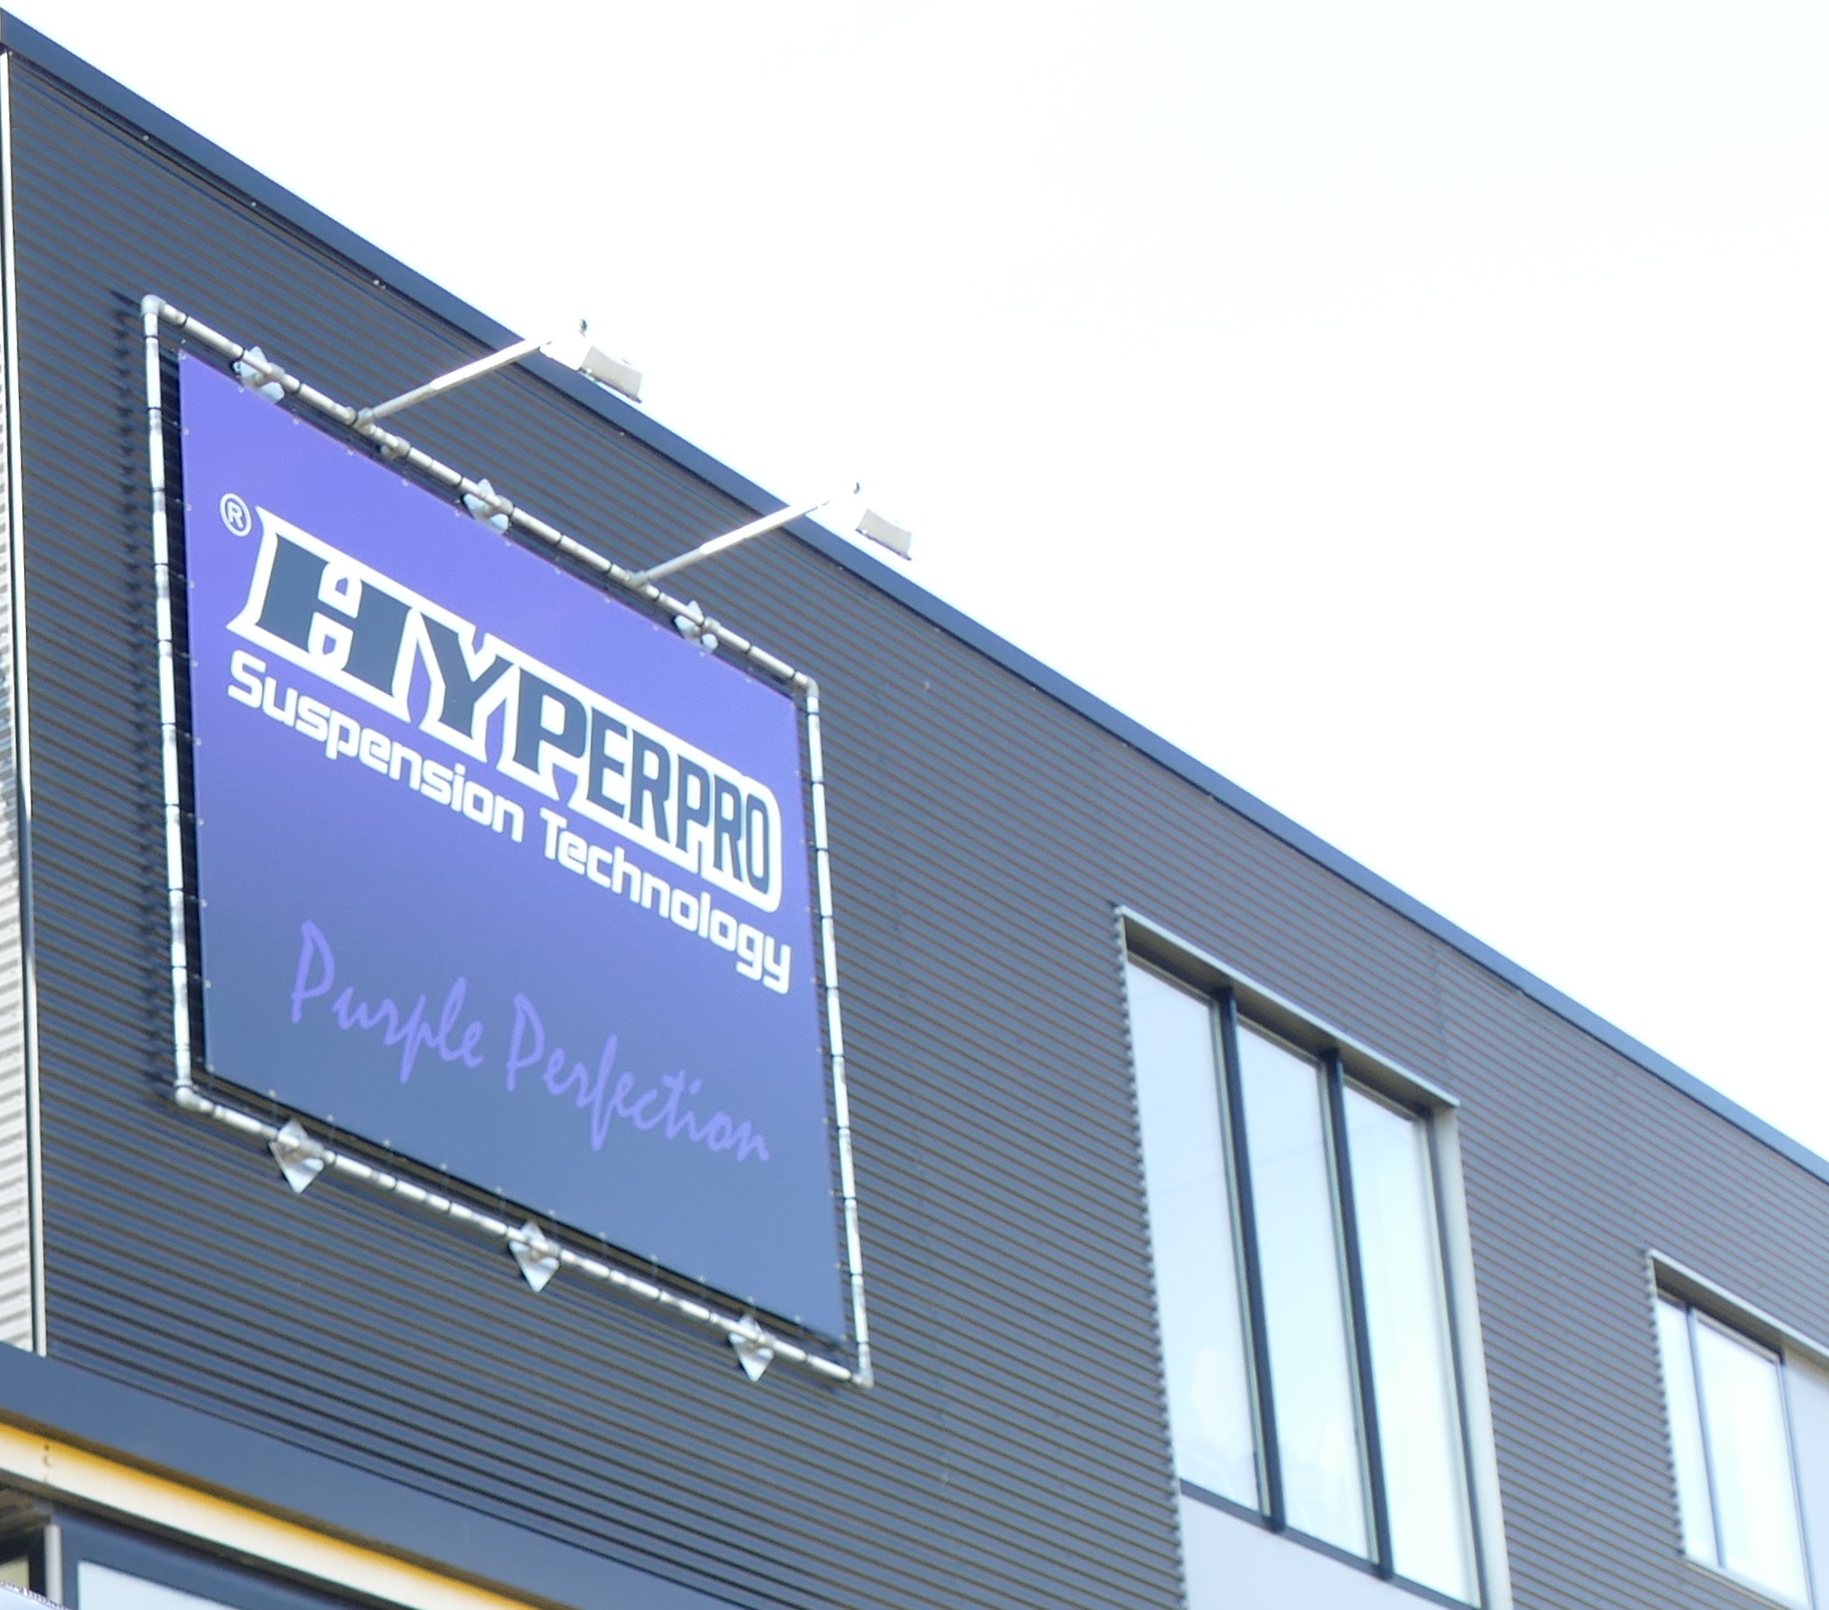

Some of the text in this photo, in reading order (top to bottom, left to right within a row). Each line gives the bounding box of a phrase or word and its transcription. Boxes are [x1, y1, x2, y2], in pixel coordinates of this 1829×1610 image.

[226, 506, 782, 913] HYPERPRO
[228, 650, 791, 995] Suspension Technology
[291, 920, 770, 1162] Purple Perfection
